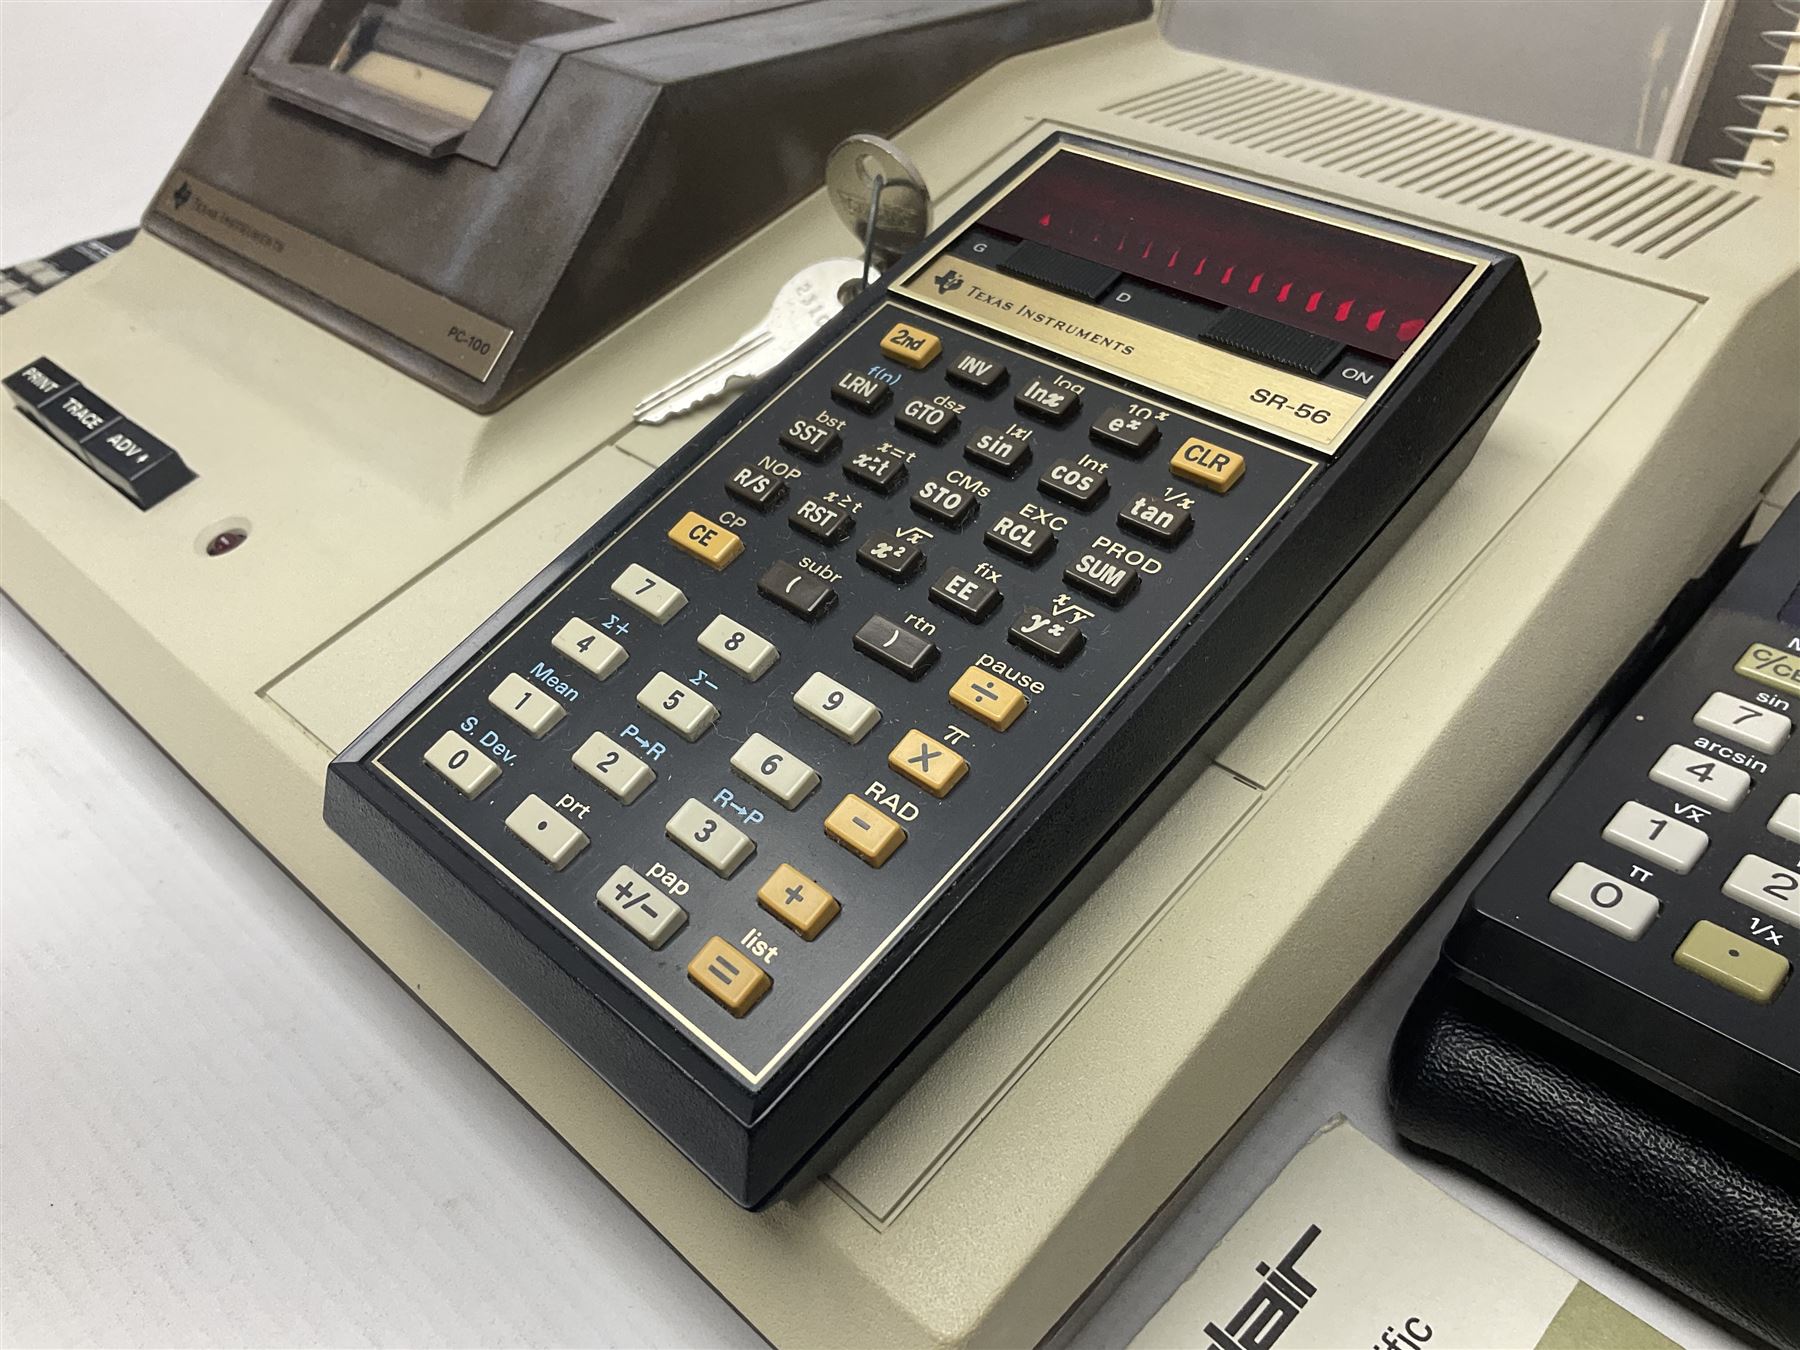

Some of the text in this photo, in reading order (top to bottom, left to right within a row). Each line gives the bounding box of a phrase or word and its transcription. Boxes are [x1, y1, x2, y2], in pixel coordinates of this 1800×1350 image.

[973, 243, 988, 253] G
[1115, 292, 1132, 303] D
[966, 285, 1135, 356] TEXAS INSTRUMENTS
[448, 326, 491, 355] PC-100
[889, 329, 927, 351] 2nd
[867, 366, 903, 386] f(n)
[958, 355, 992, 377] INV
[1341, 367, 1375, 385] ON
[22, 367, 60, 393] PRINT
[838, 372, 878, 398] LRN
[62, 397, 104, 430] TRACE
[904, 400, 945, 425] GTO
[933, 395, 968, 415] dsz
[1250, 388, 1331, 425] SR-56
[789, 420, 828, 445] SST
[816, 410, 848, 431] bst
[106, 433, 142, 457] ADV
[976, 432, 1013, 459] sin
[758, 456, 802, 481] NOP
[1077, 453, 1110, 475] Int
[1183, 444, 1231, 473] CLR
[733, 468, 770, 494] R/S
[945, 470, 991, 498] CMs
[1051, 466, 1094, 492] cos
[919, 481, 962, 511] STO
[1163, 487, 1195, 510] 1/x
[718, 511, 747, 529] CP
[797, 500, 837, 527] RST
[1018, 503, 1068, 531] EXC
[1130, 498, 1175, 528] tan
[688, 524, 718, 548] CE
[992, 517, 1037, 548] RCL
[1091, 536, 1163, 575] PROD
[798, 555, 843, 584] subr
[974, 562, 1004, 584] fix
[1075, 554, 1127, 588] SUM
[635, 578, 657, 595] 7
[944, 575, 978, 601] EE
[904, 613, 937, 636] rtn
[576, 635, 596, 653] 4
[724, 631, 746, 651] 8
[529, 661, 580, 702] Mean
[975, 653, 1046, 695] pause
[514, 692, 532, 710] 1
[662, 689, 685, 710] 5
[821, 691, 845, 711] 9
[1756, 692, 1789, 711] sin
[1733, 705, 1763, 725] 7
[460, 716, 519, 767] S. Dev.
[943, 724, 970, 745] π
[448, 749, 469, 770] 0
[597, 751, 620, 773] 2
[760, 754, 784, 776] 6
[1693, 736, 1769, 774] arcsin
[1686, 761, 1714, 783] 4
[555, 793, 592, 820] prt
[864, 781, 920, 824] RAD
[694, 819, 718, 843] 3
[1649, 819, 1668, 841] 1
[646, 862, 690, 897] pap
[1629, 865, 1654, 882] π
[1590, 881, 1623, 908] 0
[1763, 873, 1799, 901] 2
[1750, 917, 1784, 946] 1/x
[740, 927, 778, 965] list
